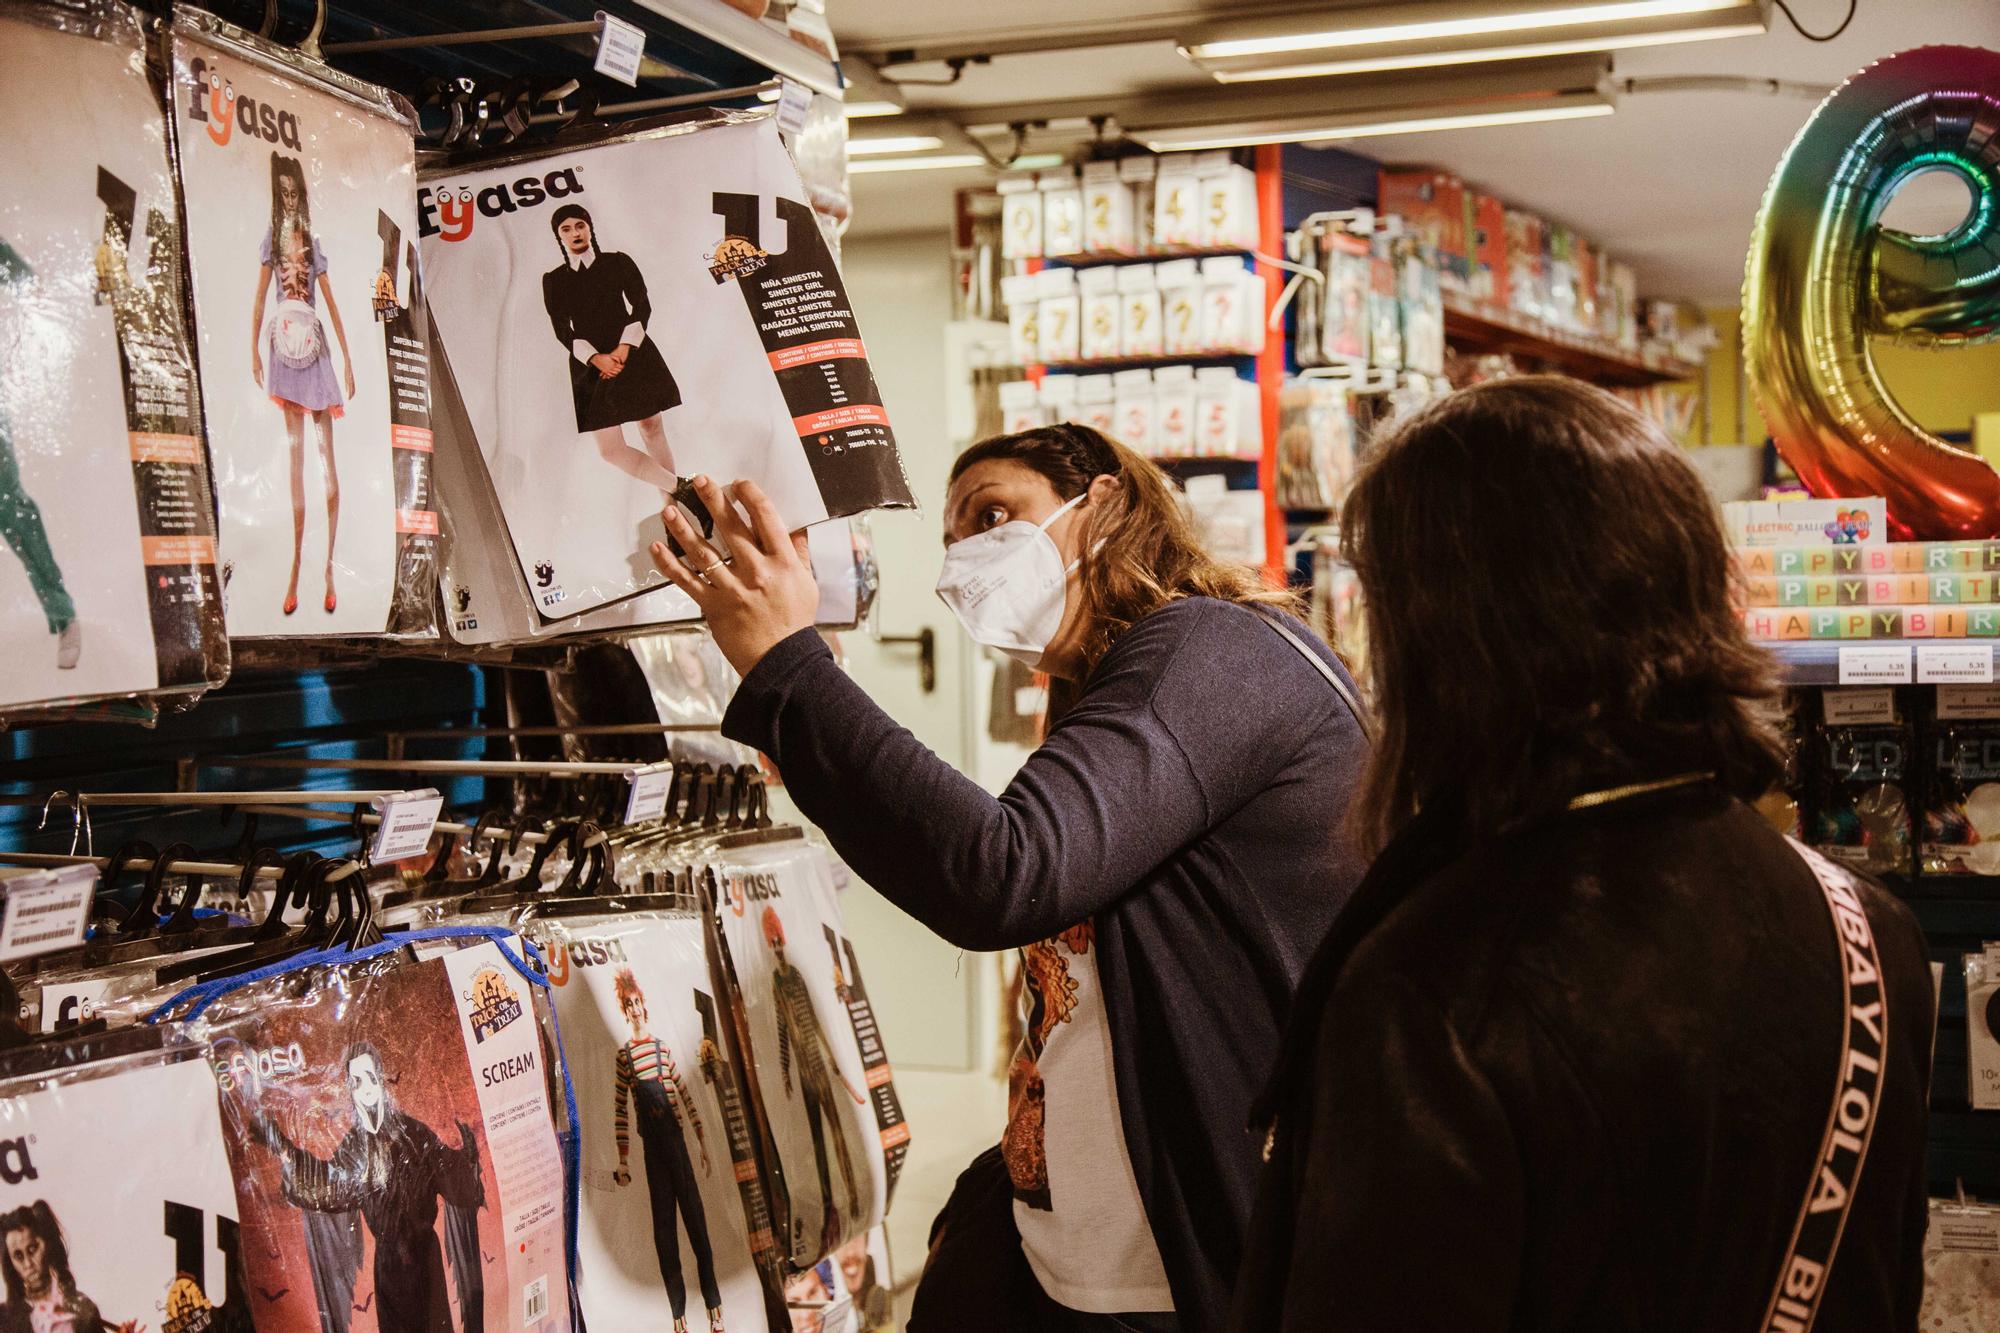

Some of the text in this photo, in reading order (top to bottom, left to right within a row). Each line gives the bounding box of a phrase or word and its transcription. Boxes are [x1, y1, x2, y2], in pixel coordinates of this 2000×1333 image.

[189, 57, 302, 148] fyasa
[1165, 189, 1184, 223] 4
[1209, 190, 1228, 228] 5
[760, 270, 823, 290] NIÑA SINIESTRA
[767, 281, 824, 298] SINISTER GIRL
[761, 290, 837, 310] SINISTER MÄDCHEN
[774, 300, 833, 318] FILLE SINISTRE
[761, 310, 852, 332] RAGAZZA TERRIFICANTE
[777, 320, 846, 338] MENINA SINISTRA
[540, 930, 628, 988] yasa
[471, 1000, 511, 1028] TRICK OR
[494, 1002, 520, 1029] TREAT
[482, 1051, 536, 1088] SCREAM
